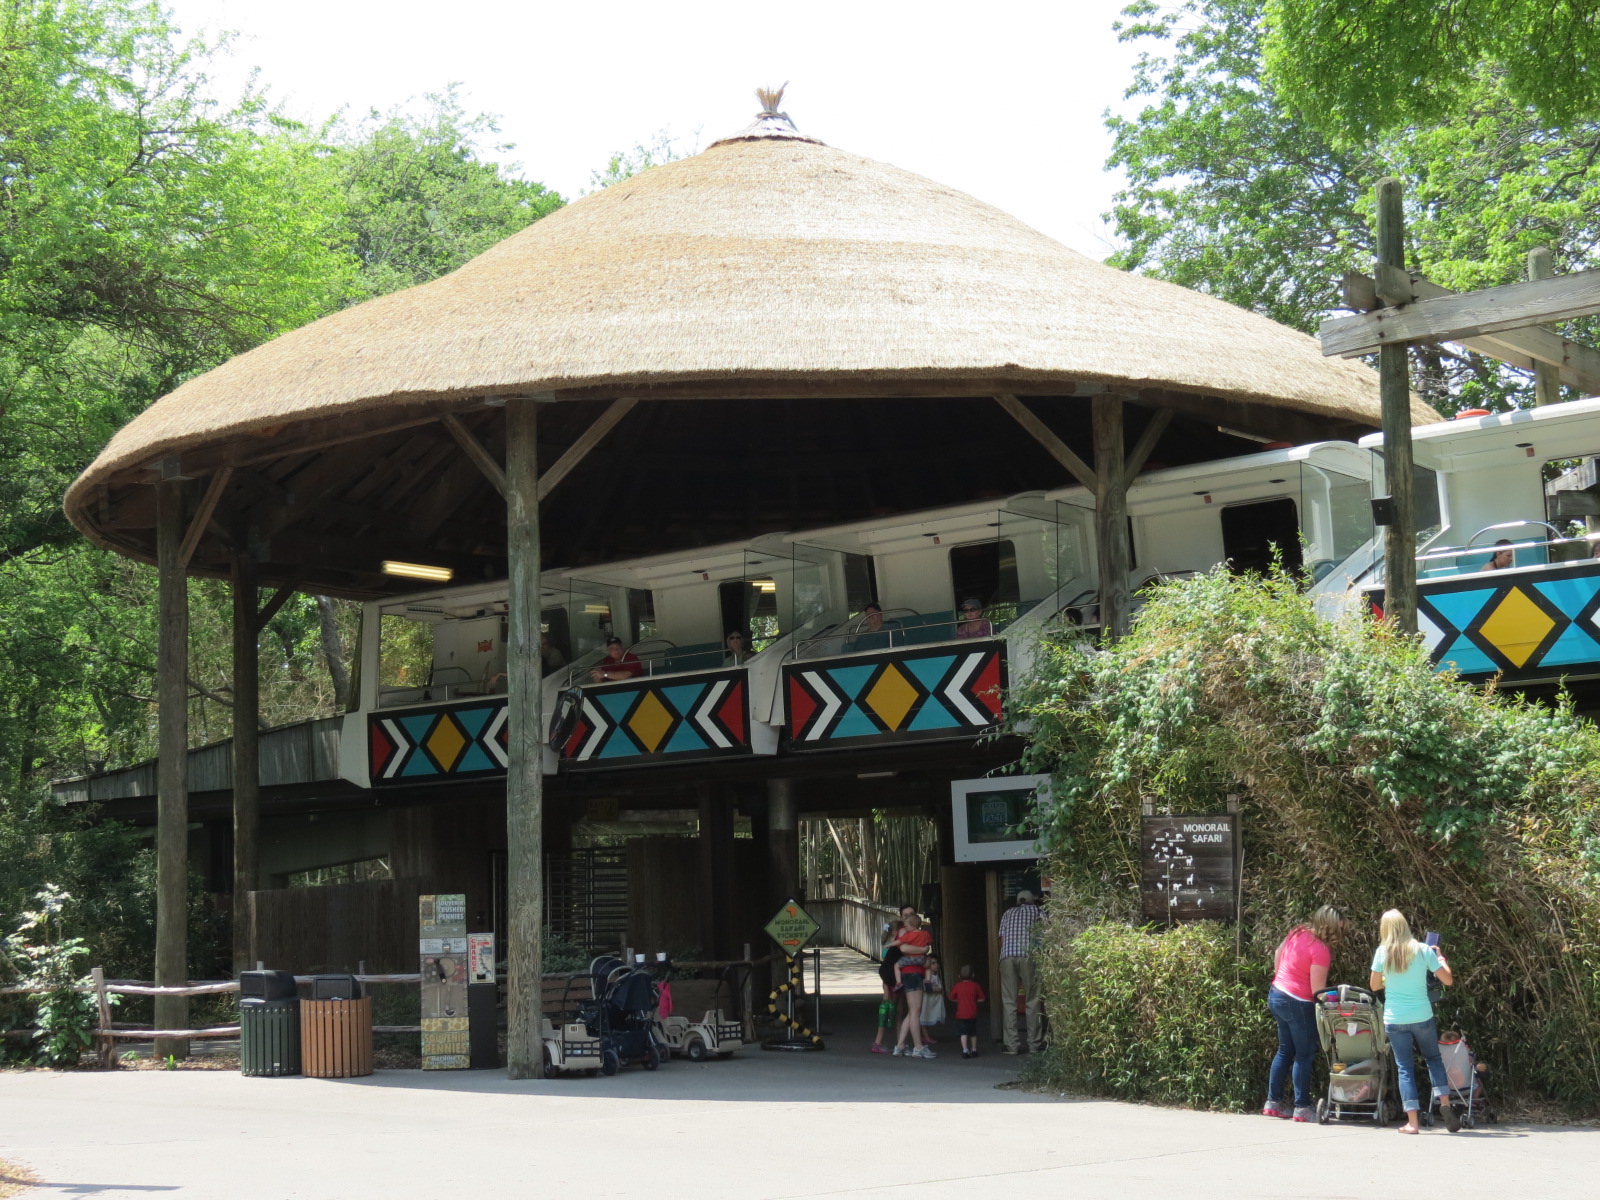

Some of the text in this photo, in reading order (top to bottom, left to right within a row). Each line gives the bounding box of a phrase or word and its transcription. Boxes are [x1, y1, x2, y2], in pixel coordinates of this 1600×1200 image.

[1183, 824, 1230, 832] MONORAIL
[1192, 834, 1222, 842] SAFARI
[425, 1033, 467, 1042] SOUVENIR
[425, 1043, 467, 1054] PENNIES
